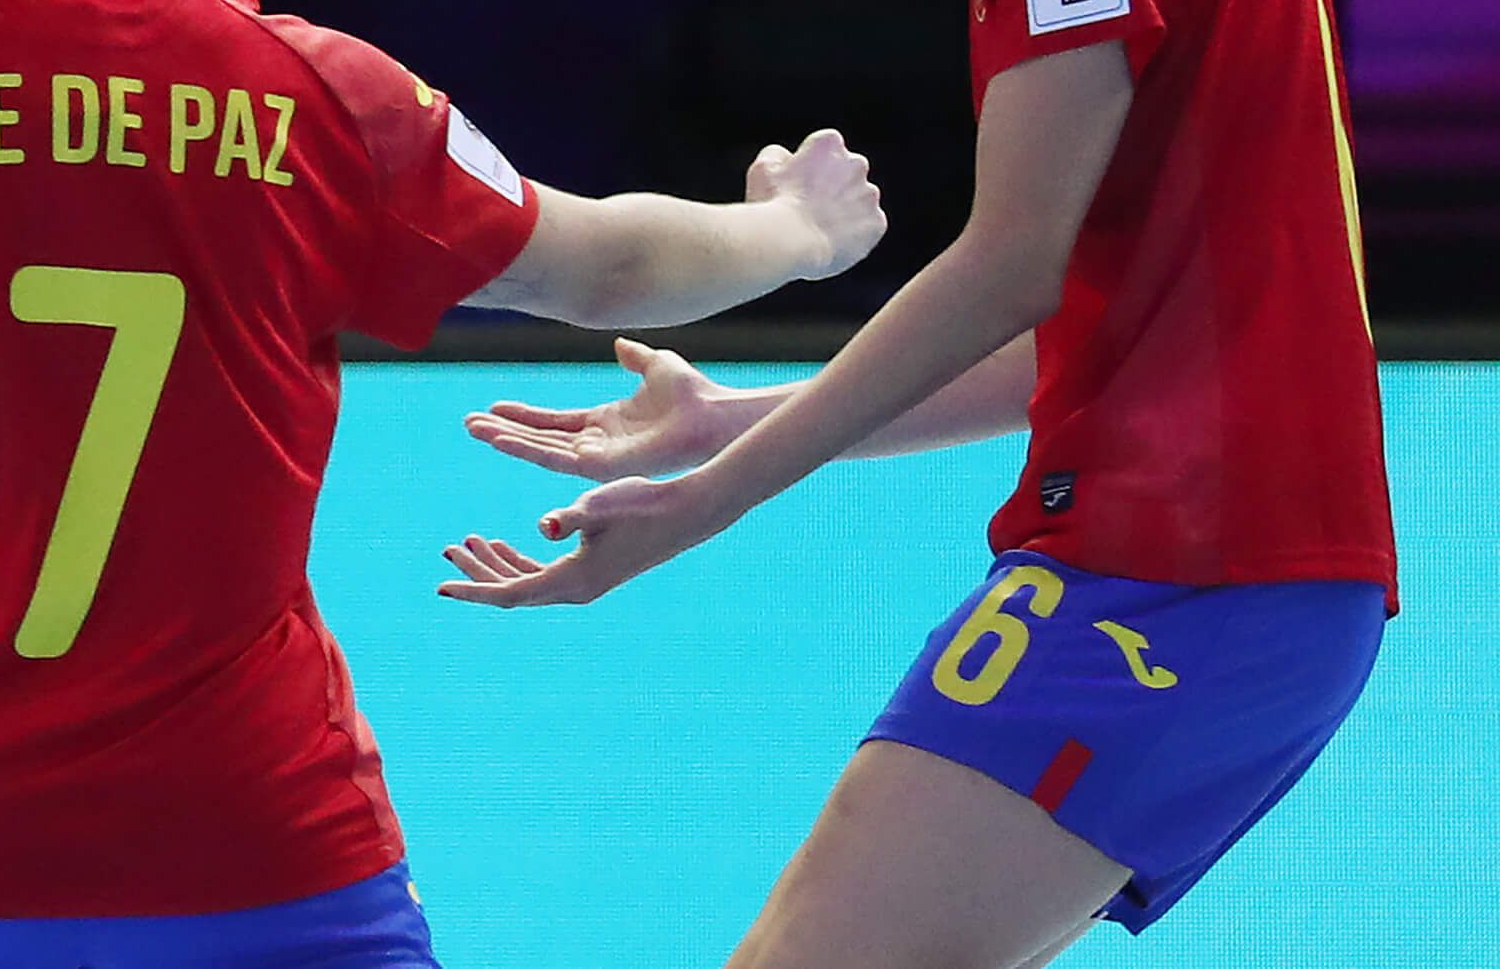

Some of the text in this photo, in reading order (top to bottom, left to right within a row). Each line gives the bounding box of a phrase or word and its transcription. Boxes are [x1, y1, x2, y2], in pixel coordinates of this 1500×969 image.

[51, 73, 147, 168] DE
[169, 83, 296, 187] PAZ
[10, 264, 187, 659] 7
[932, 565, 1065, 706] 6
